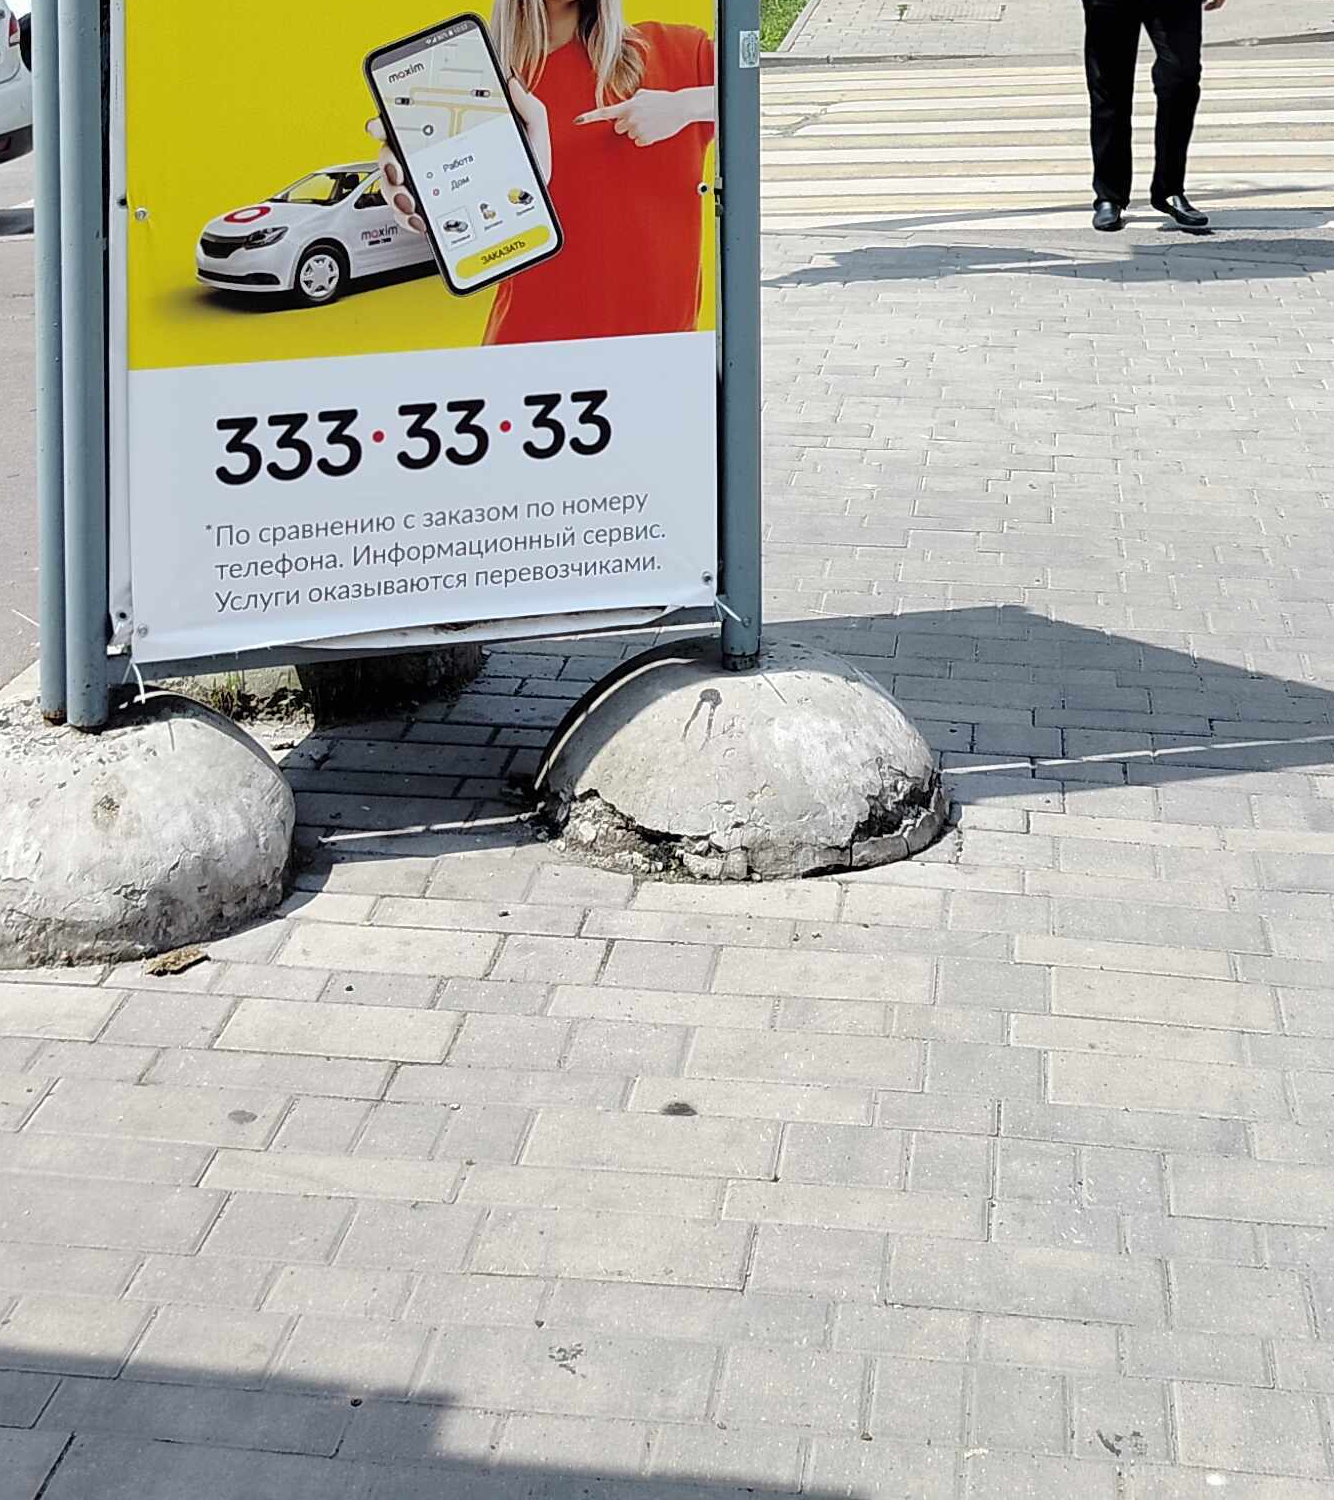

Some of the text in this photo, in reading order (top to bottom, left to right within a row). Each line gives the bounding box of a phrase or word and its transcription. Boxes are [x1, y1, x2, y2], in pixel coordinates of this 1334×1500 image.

[388, 61, 424, 84] maxim
[442, 154, 474, 173] Работа
[450, 176, 470, 191] Дом
[361, 224, 399, 241] maxim
[481, 240, 526, 265] ЗАКАЗАТЬ
[258, 515, 396, 548] сравнению
[403, 513, 415, 530] с
[422, 504, 519, 528] заказом
[526, 501, 555, 519] по
[562, 492, 649, 515] номеру
[214, 523, 666, 580] телефона. Информационный сервис.
[215, 555, 662, 613] Услуги оказываются перевозчиками.
